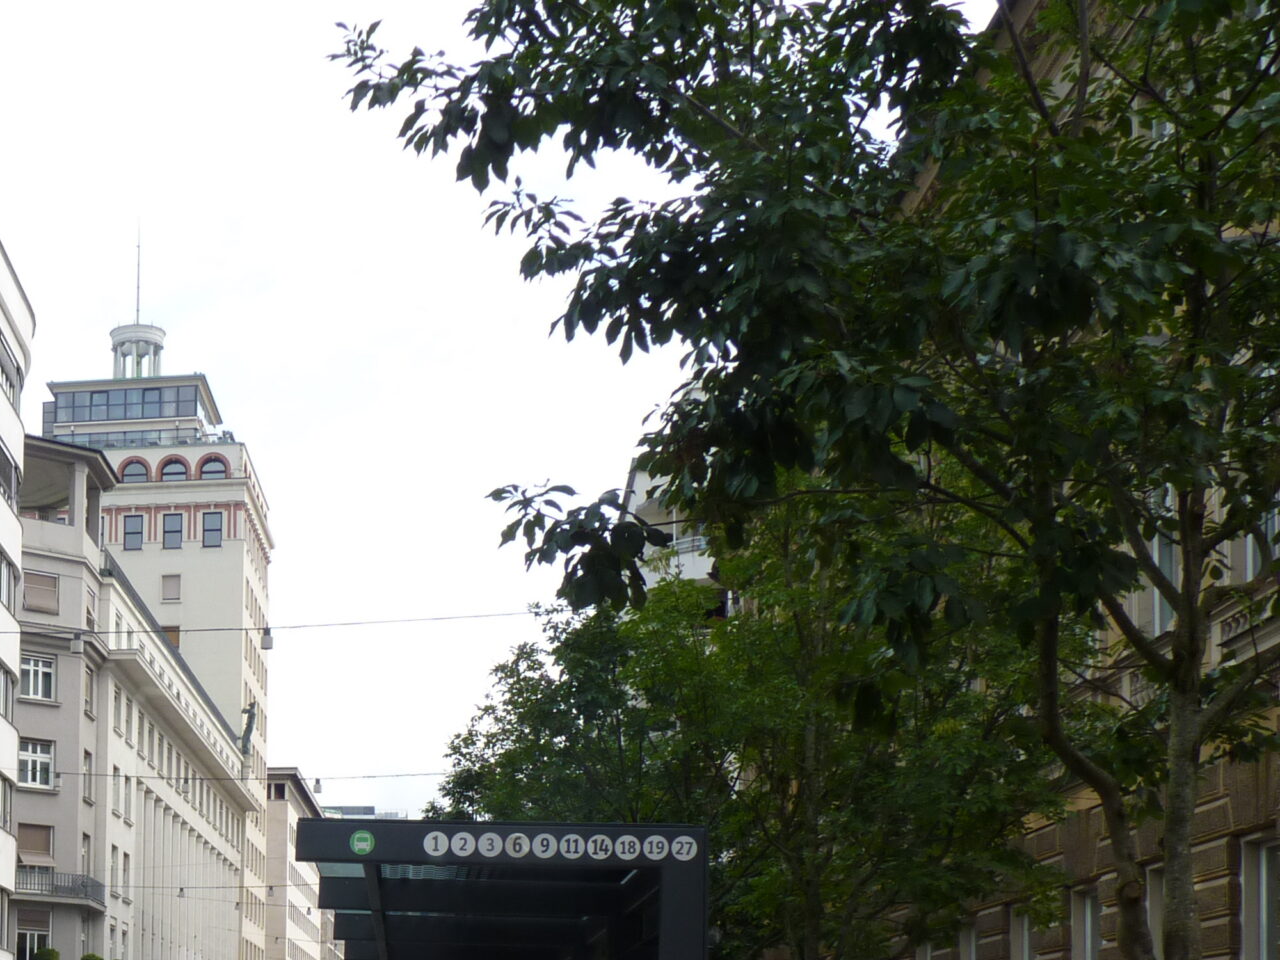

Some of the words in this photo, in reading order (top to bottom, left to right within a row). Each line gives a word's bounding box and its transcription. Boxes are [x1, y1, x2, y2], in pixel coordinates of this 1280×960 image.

[431, 835, 440, 852] 1
[458, 837, 468, 851] 2
[486, 837, 495, 852] 3
[512, 836, 522, 853] 6
[540, 837, 550, 853] 9
[564, 838, 580, 854] 11
[591, 838, 609, 855] 14
[620, 840, 637, 854] 18
[647, 840, 665, 855] 19
[675, 841, 694, 855] 27
